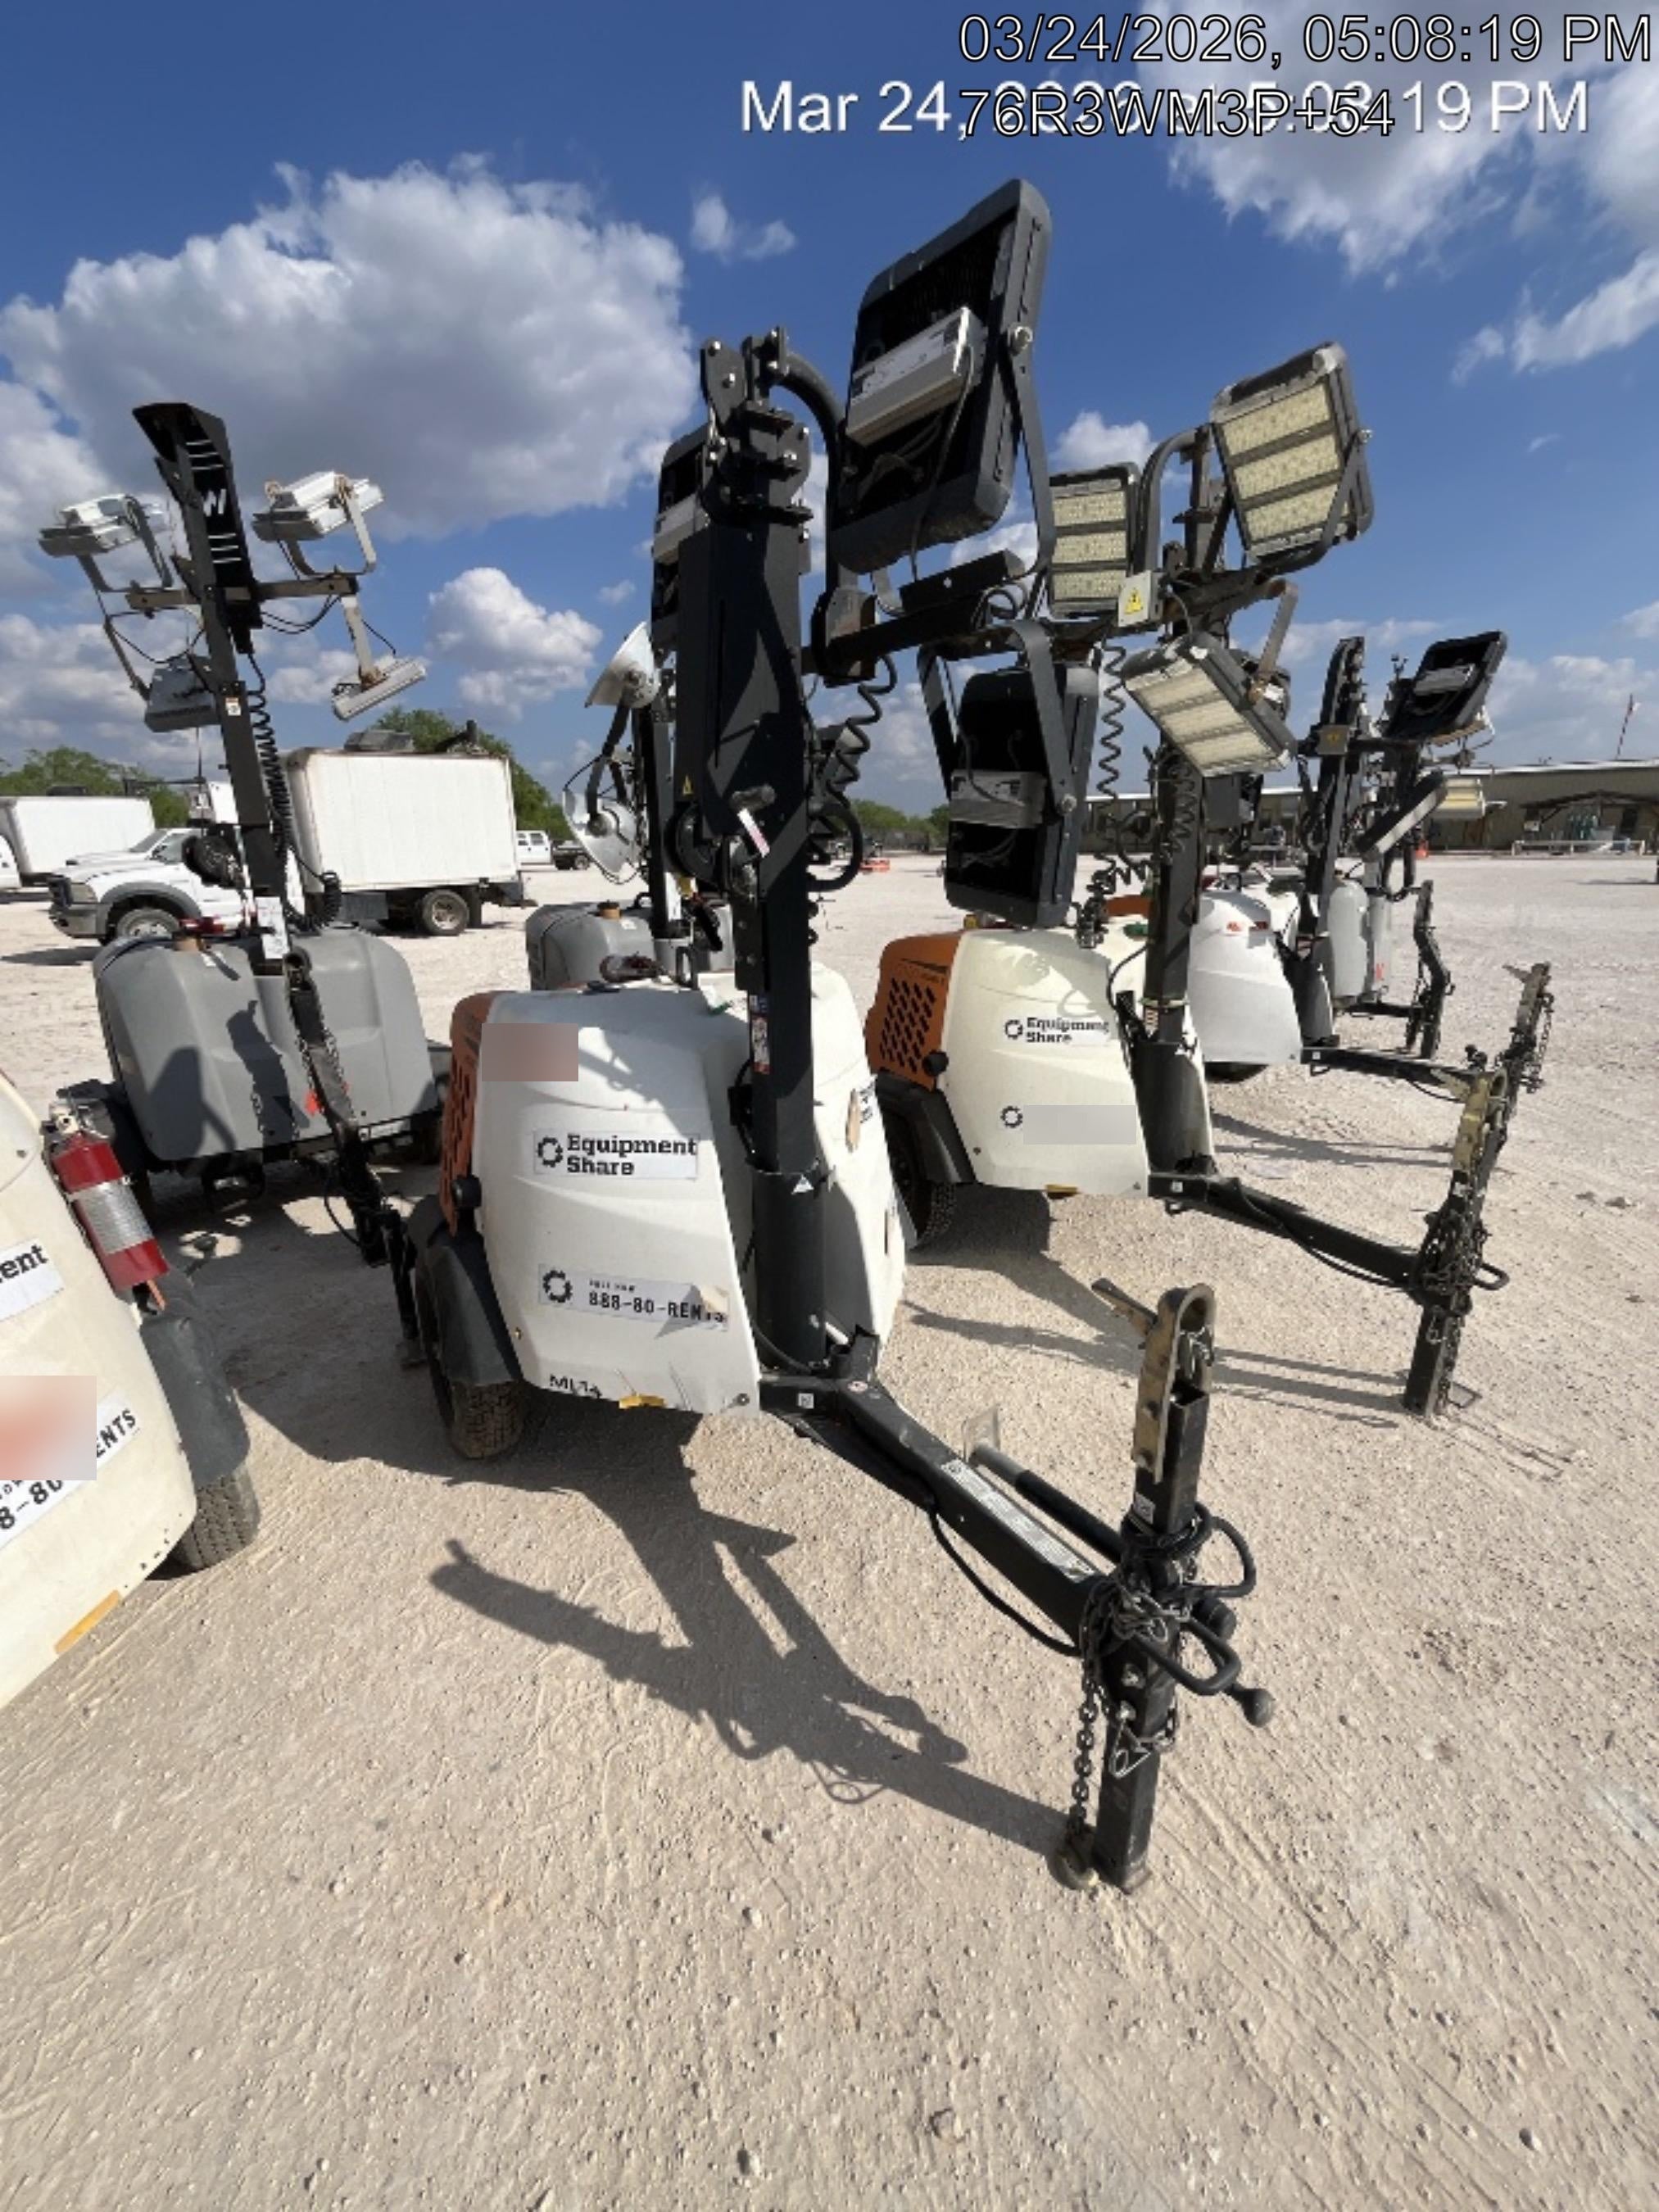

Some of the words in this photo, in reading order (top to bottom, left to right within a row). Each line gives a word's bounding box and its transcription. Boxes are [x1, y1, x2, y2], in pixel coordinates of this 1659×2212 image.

[1027, 1017, 1109, 1033] Equipment
[1027, 1031, 1072, 1044] Share
[567, 1133, 698, 1158] Equipment
[567, 1154, 635, 1176] Share
